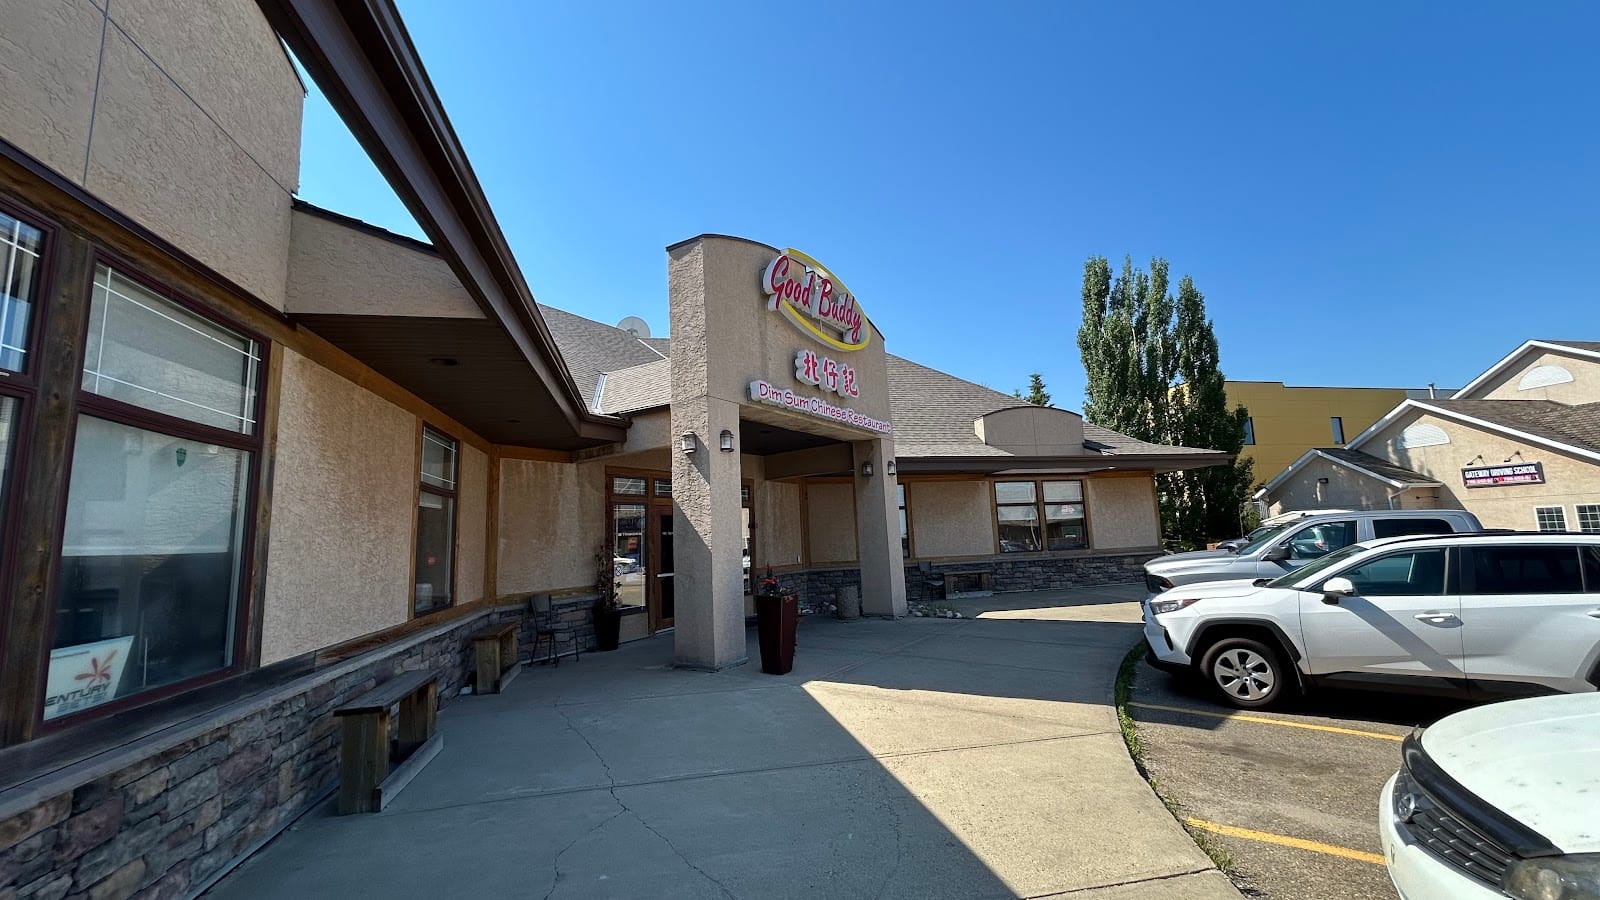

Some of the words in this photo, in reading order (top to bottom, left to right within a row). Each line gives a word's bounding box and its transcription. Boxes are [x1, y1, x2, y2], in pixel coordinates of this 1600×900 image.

[771, 256, 814, 309] Good
[818, 278, 862, 343] Buddy
[759, 383, 782, 401] Dim
[784, 391, 809, 410] Sum
[811, 399, 847, 420] Chinese
[847, 409, 892, 433] Restaurant
[1513, 465, 1538, 475] SCHOOL
